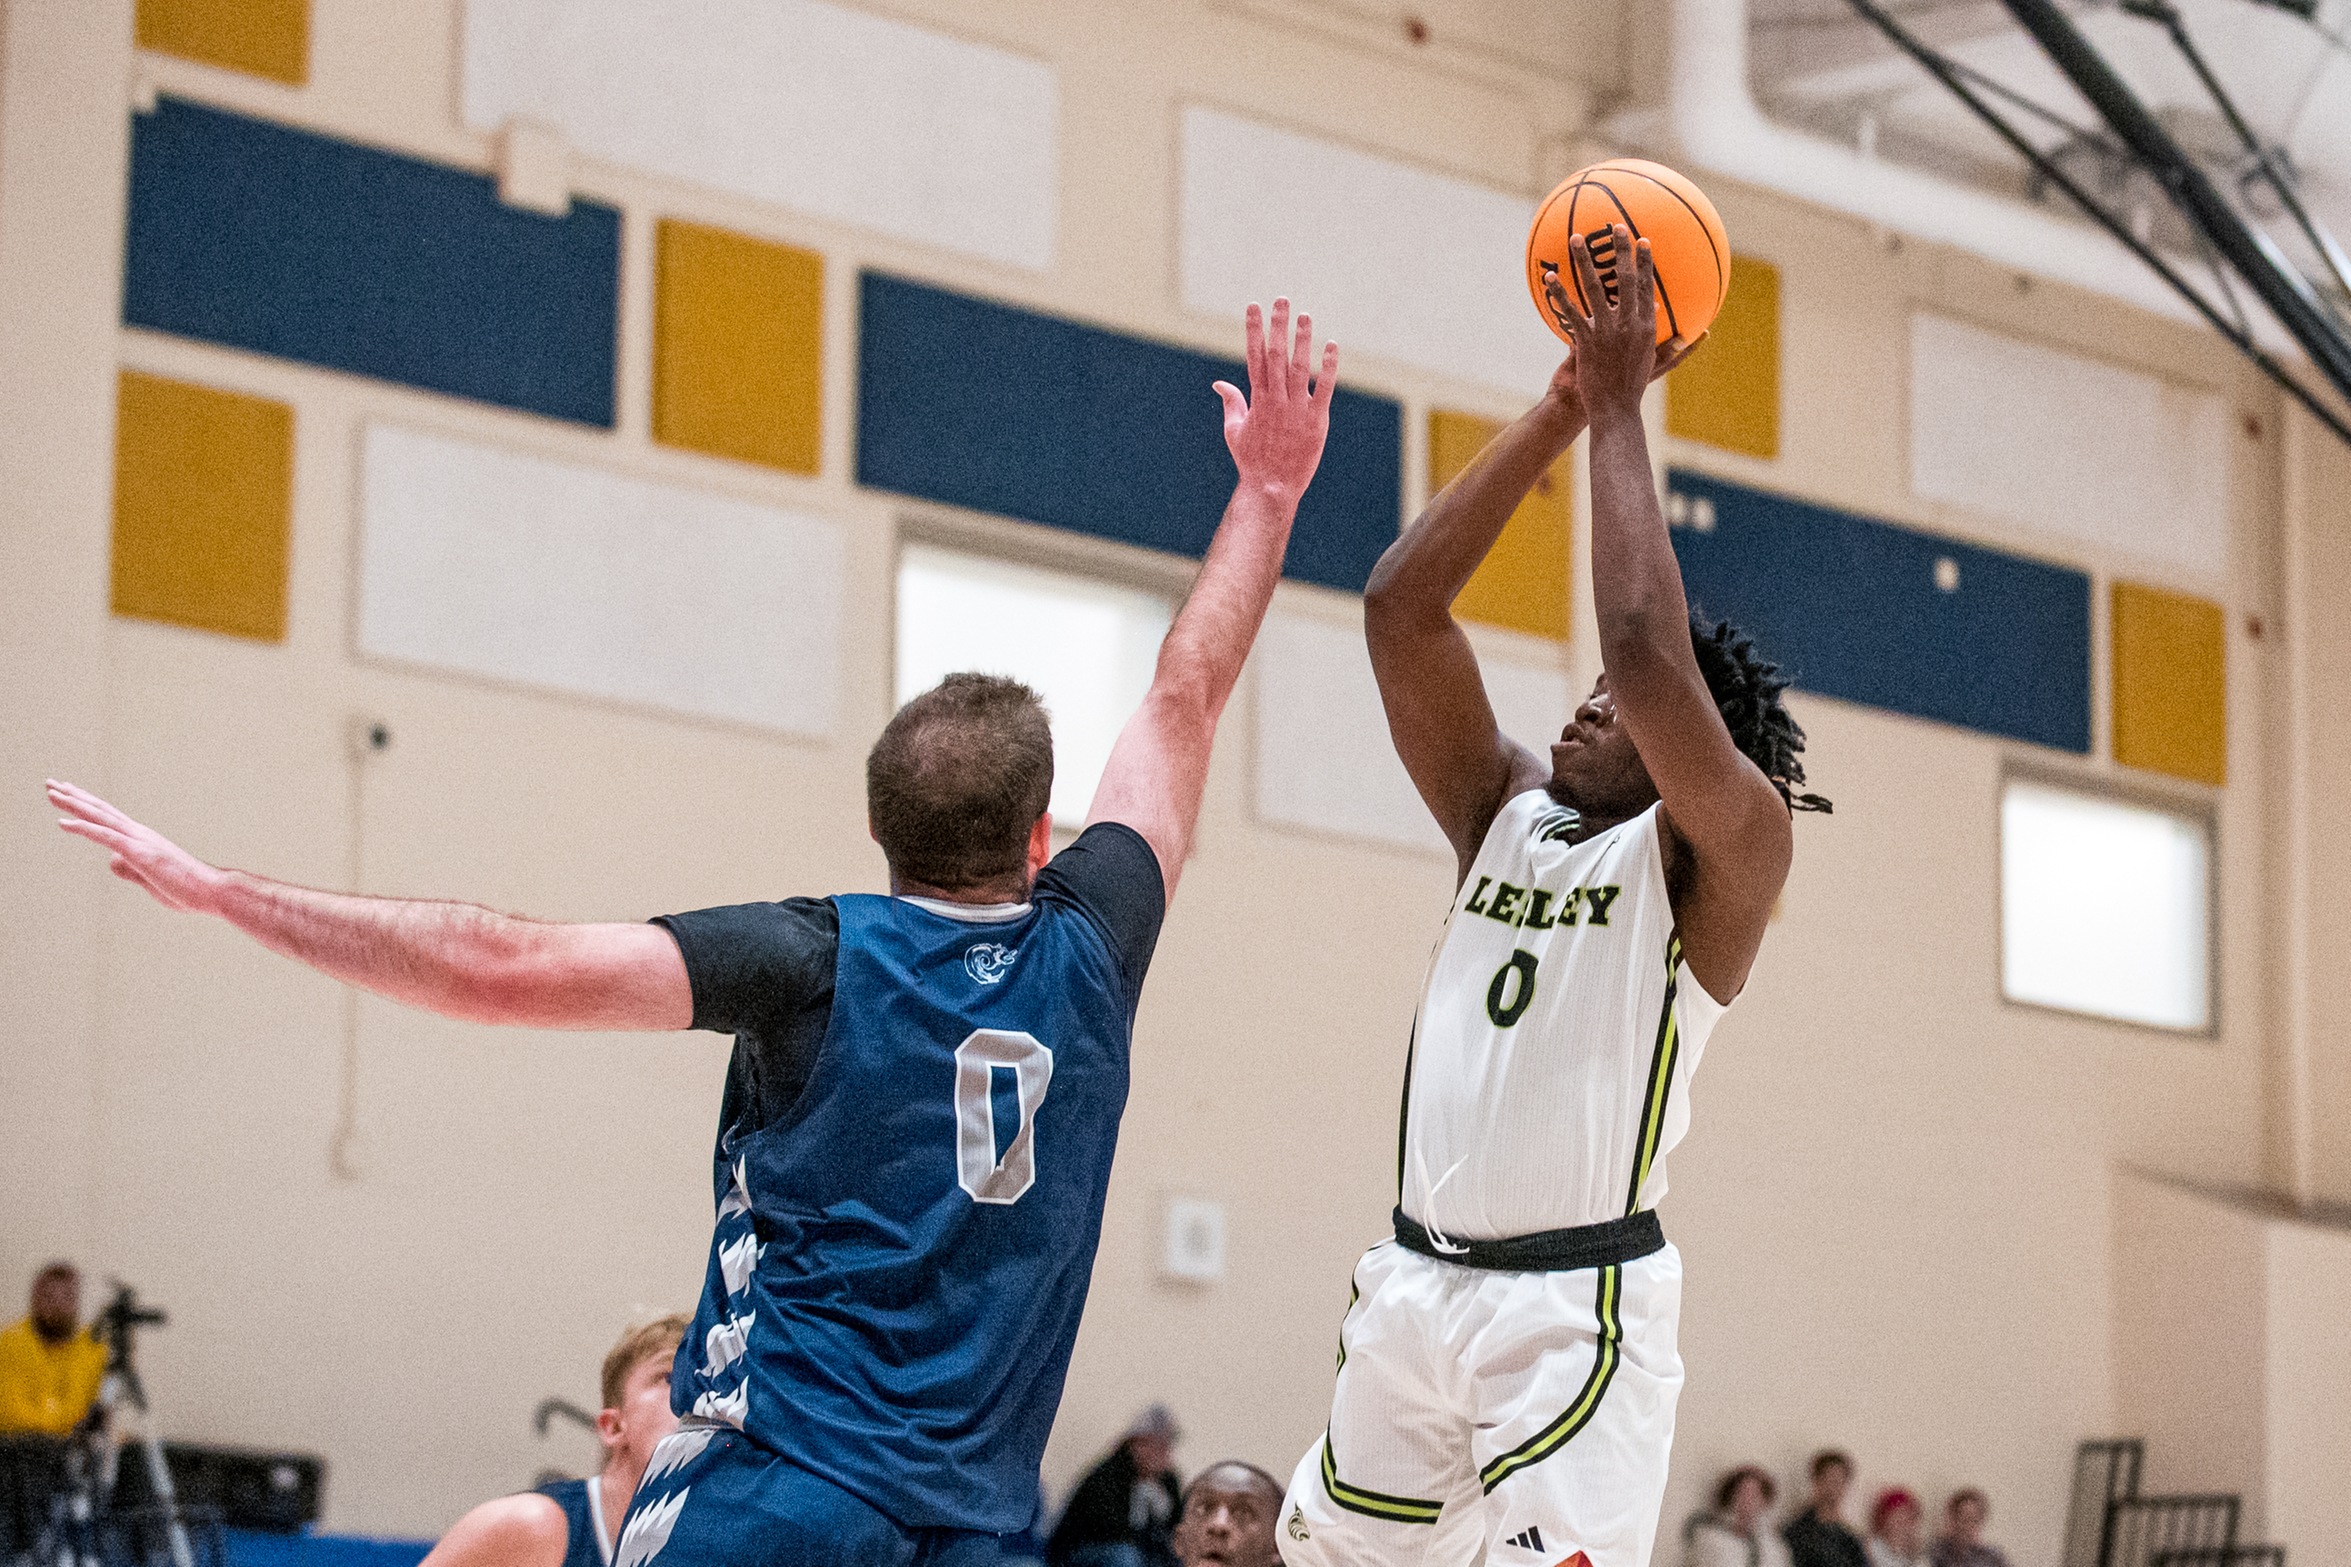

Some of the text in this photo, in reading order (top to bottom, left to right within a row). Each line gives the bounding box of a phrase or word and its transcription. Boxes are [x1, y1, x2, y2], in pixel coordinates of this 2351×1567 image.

[1464, 875, 1621, 930] LELEY
[1485, 948, 1539, 1028] 0
[954, 1028, 1053, 1204] 0
